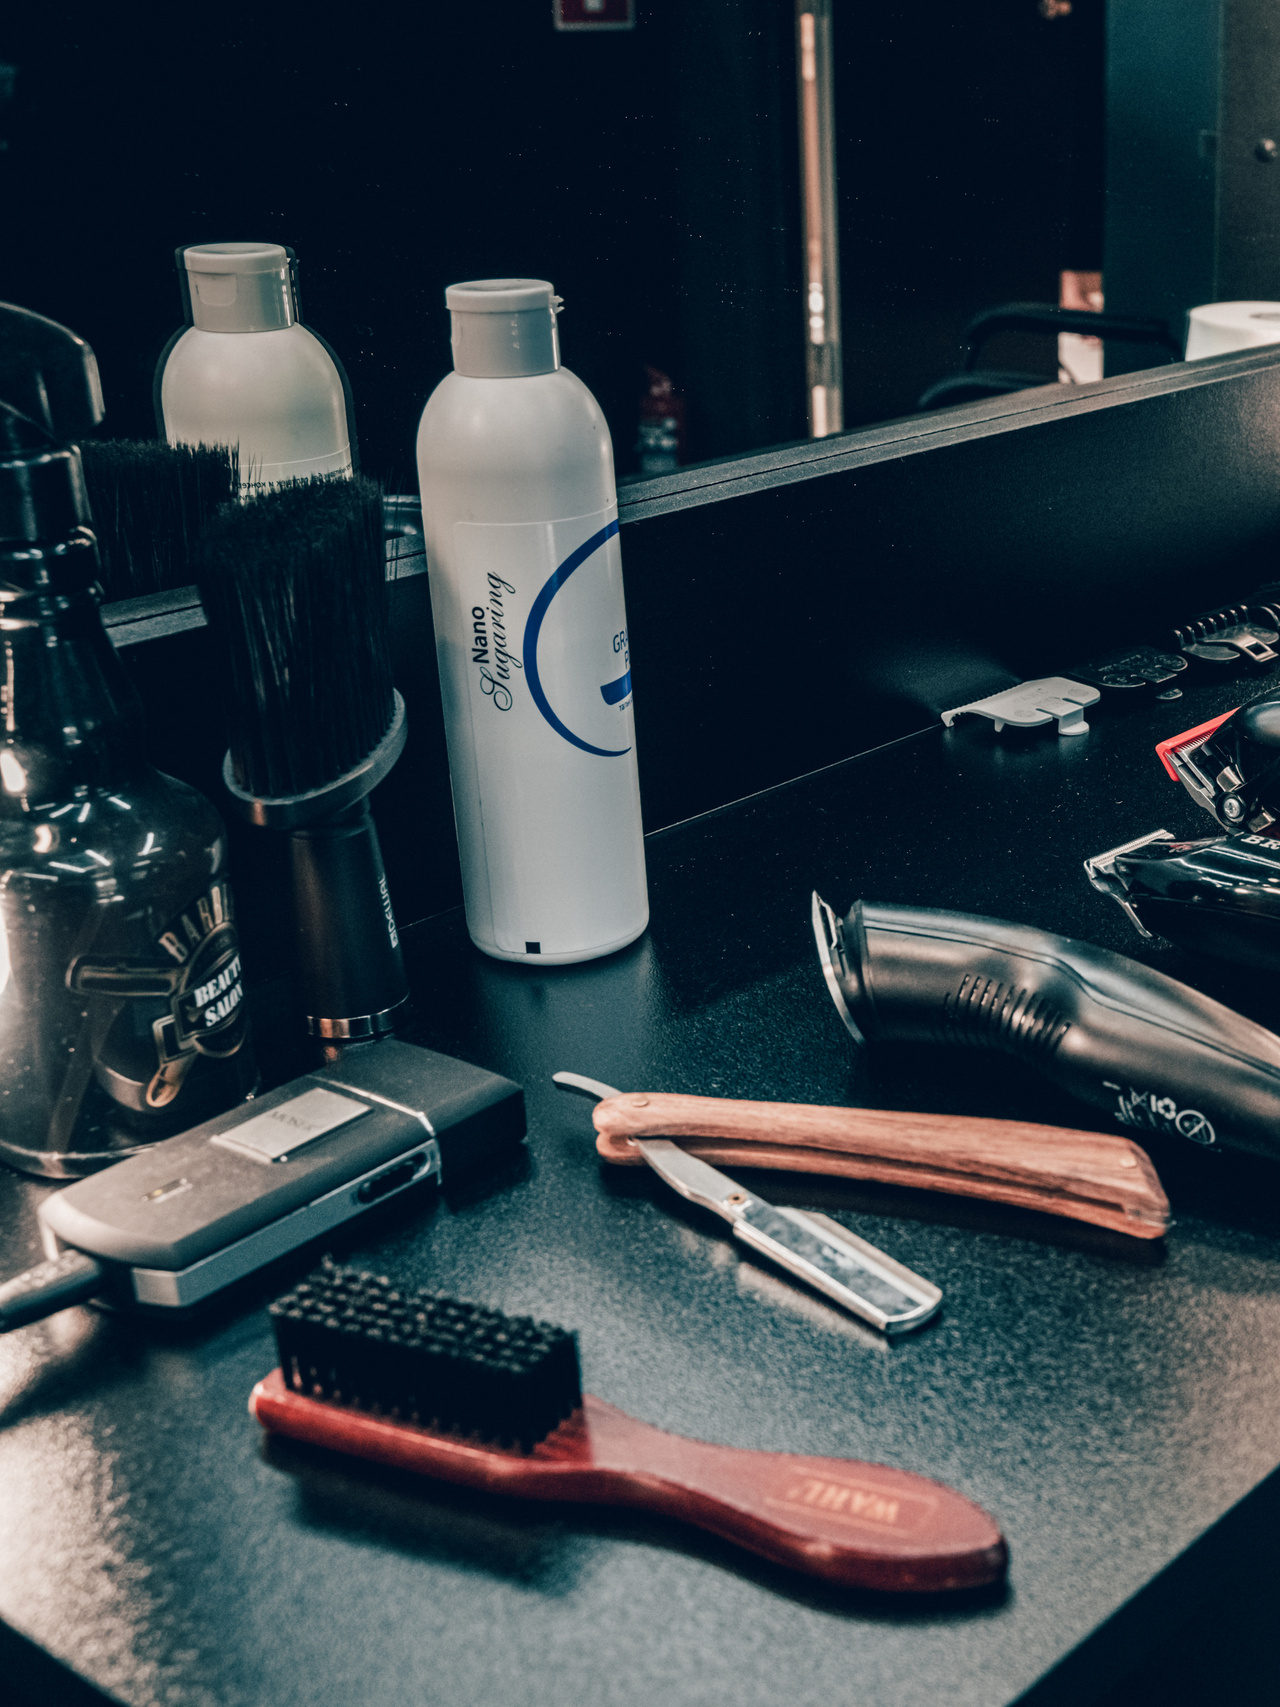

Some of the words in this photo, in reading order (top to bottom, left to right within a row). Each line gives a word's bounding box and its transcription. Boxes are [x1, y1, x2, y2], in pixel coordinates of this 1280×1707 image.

[471, 606, 490, 664] Nano
[480, 571, 522, 712] Sugaring
[193, 954, 242, 1008] BEAUT
